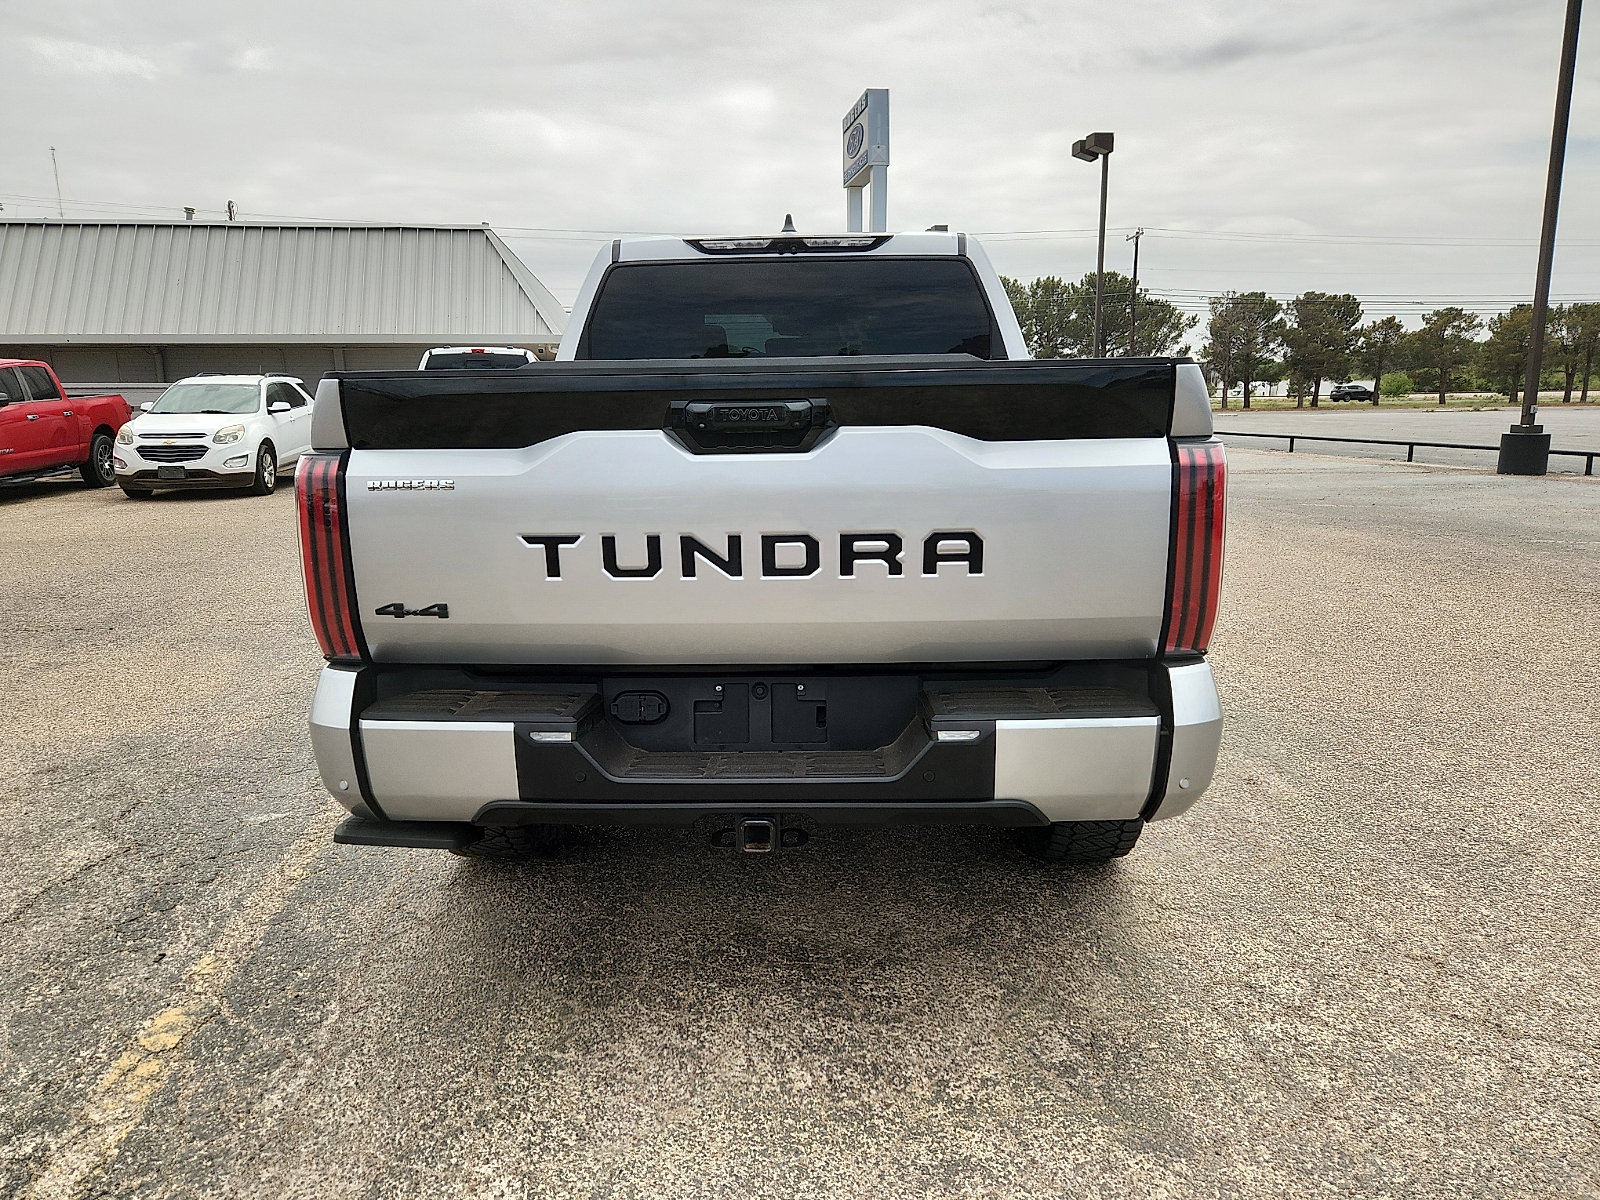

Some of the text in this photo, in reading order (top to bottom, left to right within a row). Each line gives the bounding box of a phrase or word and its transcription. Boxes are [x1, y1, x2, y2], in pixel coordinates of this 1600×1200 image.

[719, 408, 778, 421] TOYOTA
[367, 479, 455, 491] ROGERS
[518, 530, 985, 581] TUNDRA
